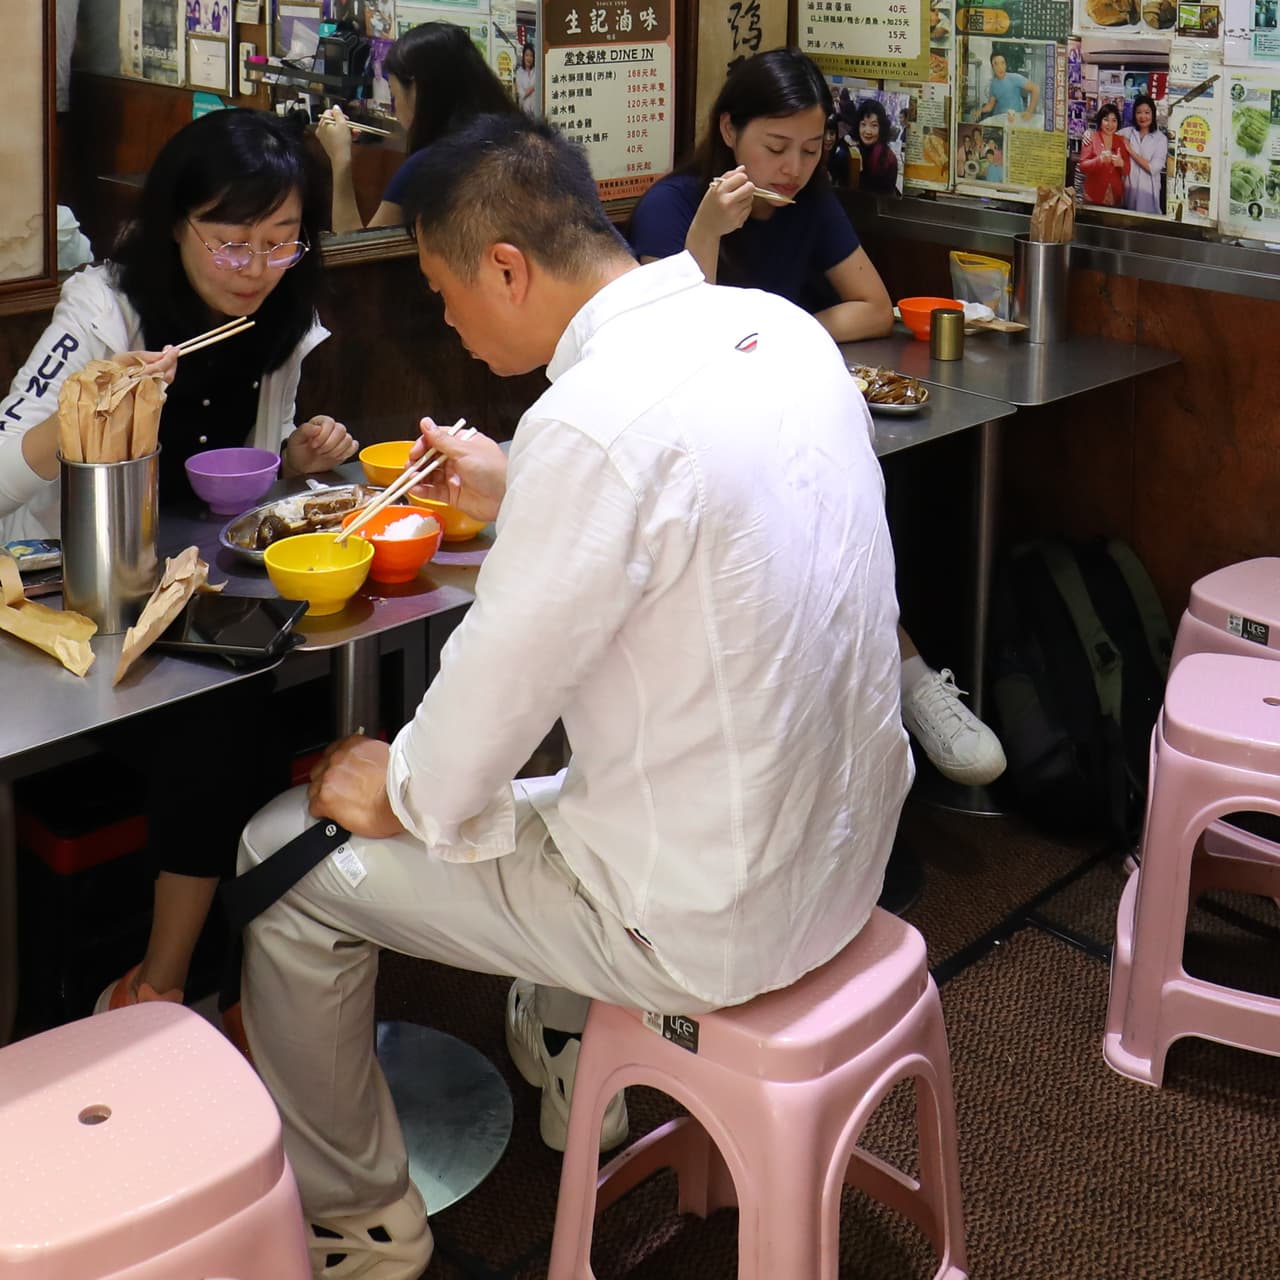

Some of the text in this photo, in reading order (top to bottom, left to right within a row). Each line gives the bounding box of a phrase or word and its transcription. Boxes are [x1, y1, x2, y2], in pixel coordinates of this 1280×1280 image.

[888, 5, 907, 13] 40元
[565, 7, 658, 35] 生記滷味
[888, 31, 907, 40] 15元
[888, 45, 902, 54] 5元
[610, 49, 638, 61] DINE
[642, 48, 654, 59] IN
[626, 144, 643, 153] 40元
[25, 332, 79, 398] RUN
